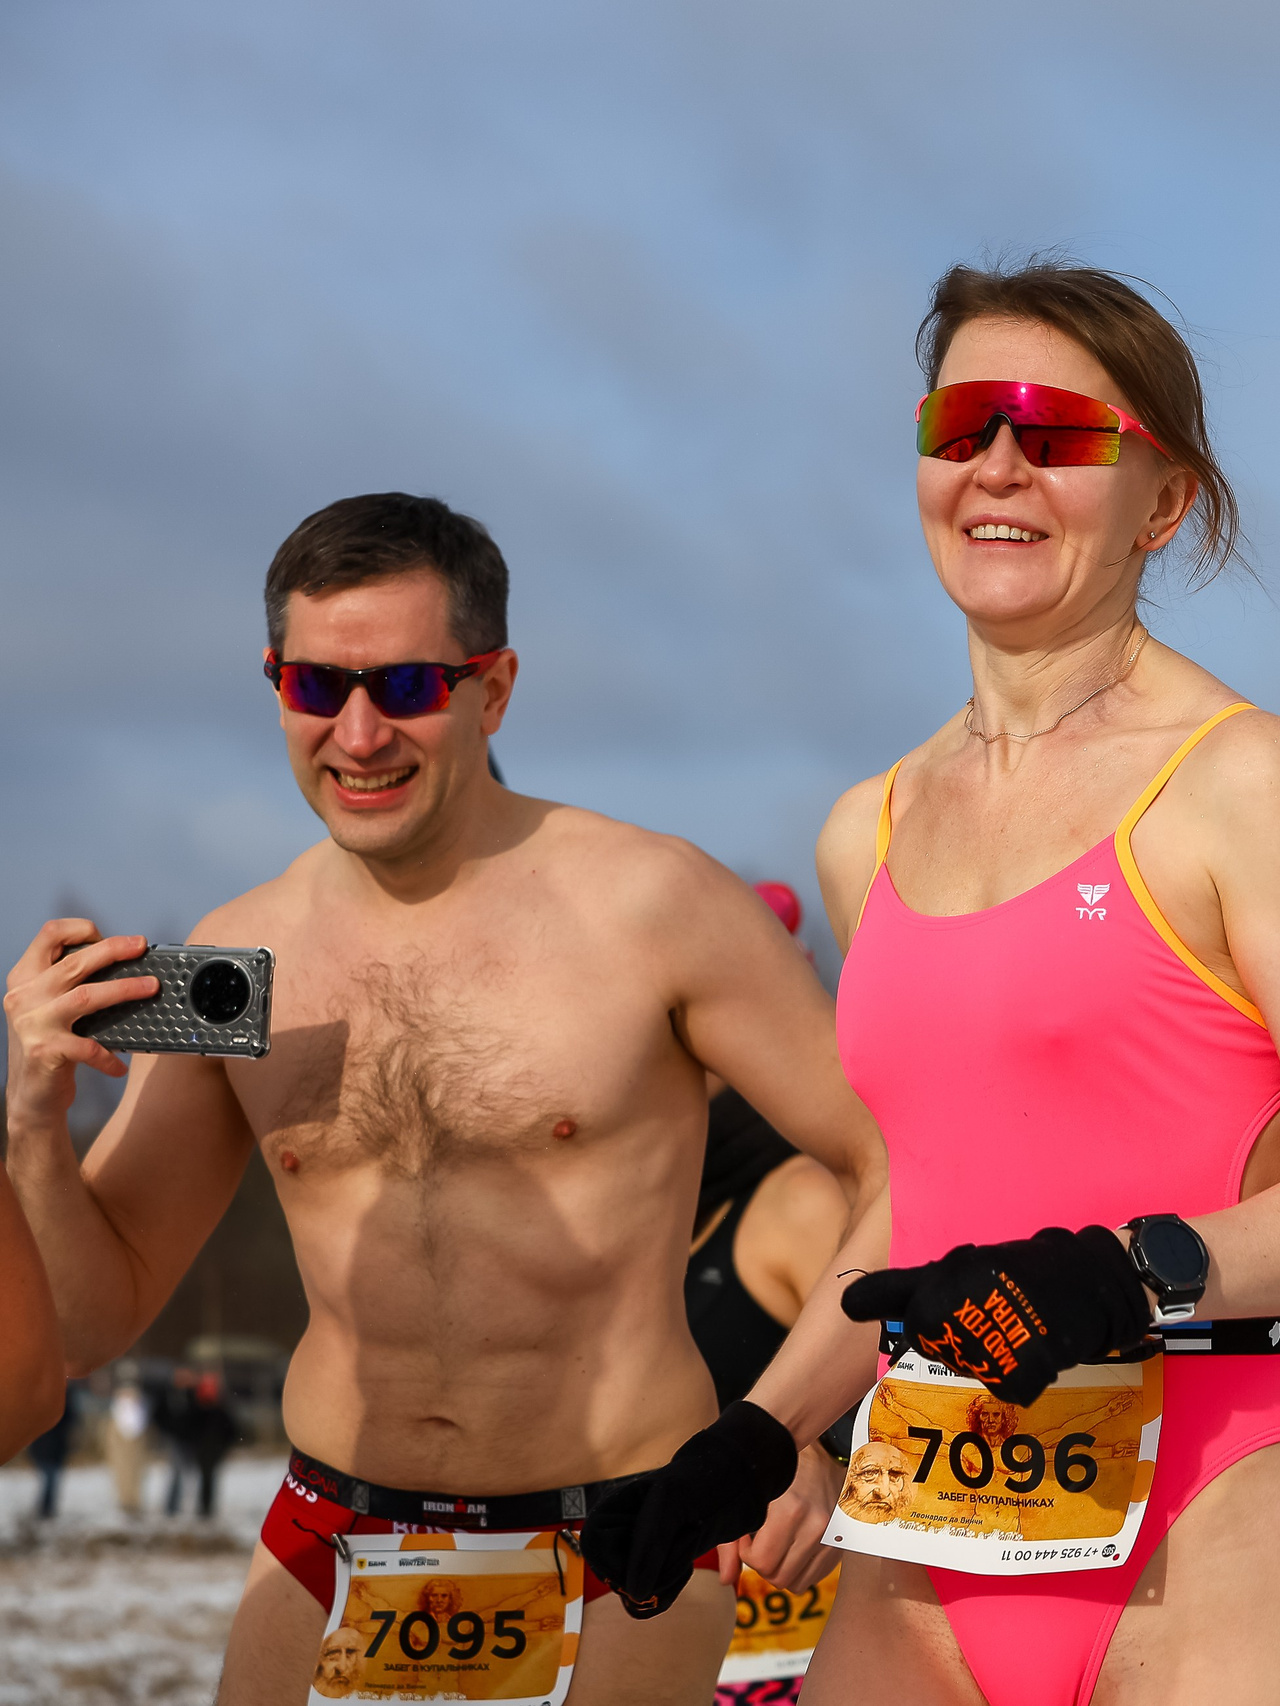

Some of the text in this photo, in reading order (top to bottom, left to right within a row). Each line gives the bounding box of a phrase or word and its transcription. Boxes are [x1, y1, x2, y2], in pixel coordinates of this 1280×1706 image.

[1075, 907, 1107, 920] TYR
[999, 1272, 1047, 1335] OBSESSION
[984, 1288, 1031, 1349] ULTRA
[953, 1298, 1018, 1375] MAD FOX
[908, 1426, 1098, 1494] 7096
[937, 1491, 1055, 1508] ЗАБЕГ В КУПАЛЬНИКАХ
[910, 1511, 948, 1523] Леонардо
[960, 1516, 983, 1525] Винчи
[1001, 1550, 1011, 1561] 11
[1014, 1550, 1032, 1561] 00
[1034, 1549, 1059, 1560] 444
[1060, 1547, 1082, 1559] 925
[364, 1610, 527, 1660] 7095
[383, 1663, 411, 1672] ЗАБЕГ
[421, 1663, 490, 1672] КУПАЛЬНИКАХ
